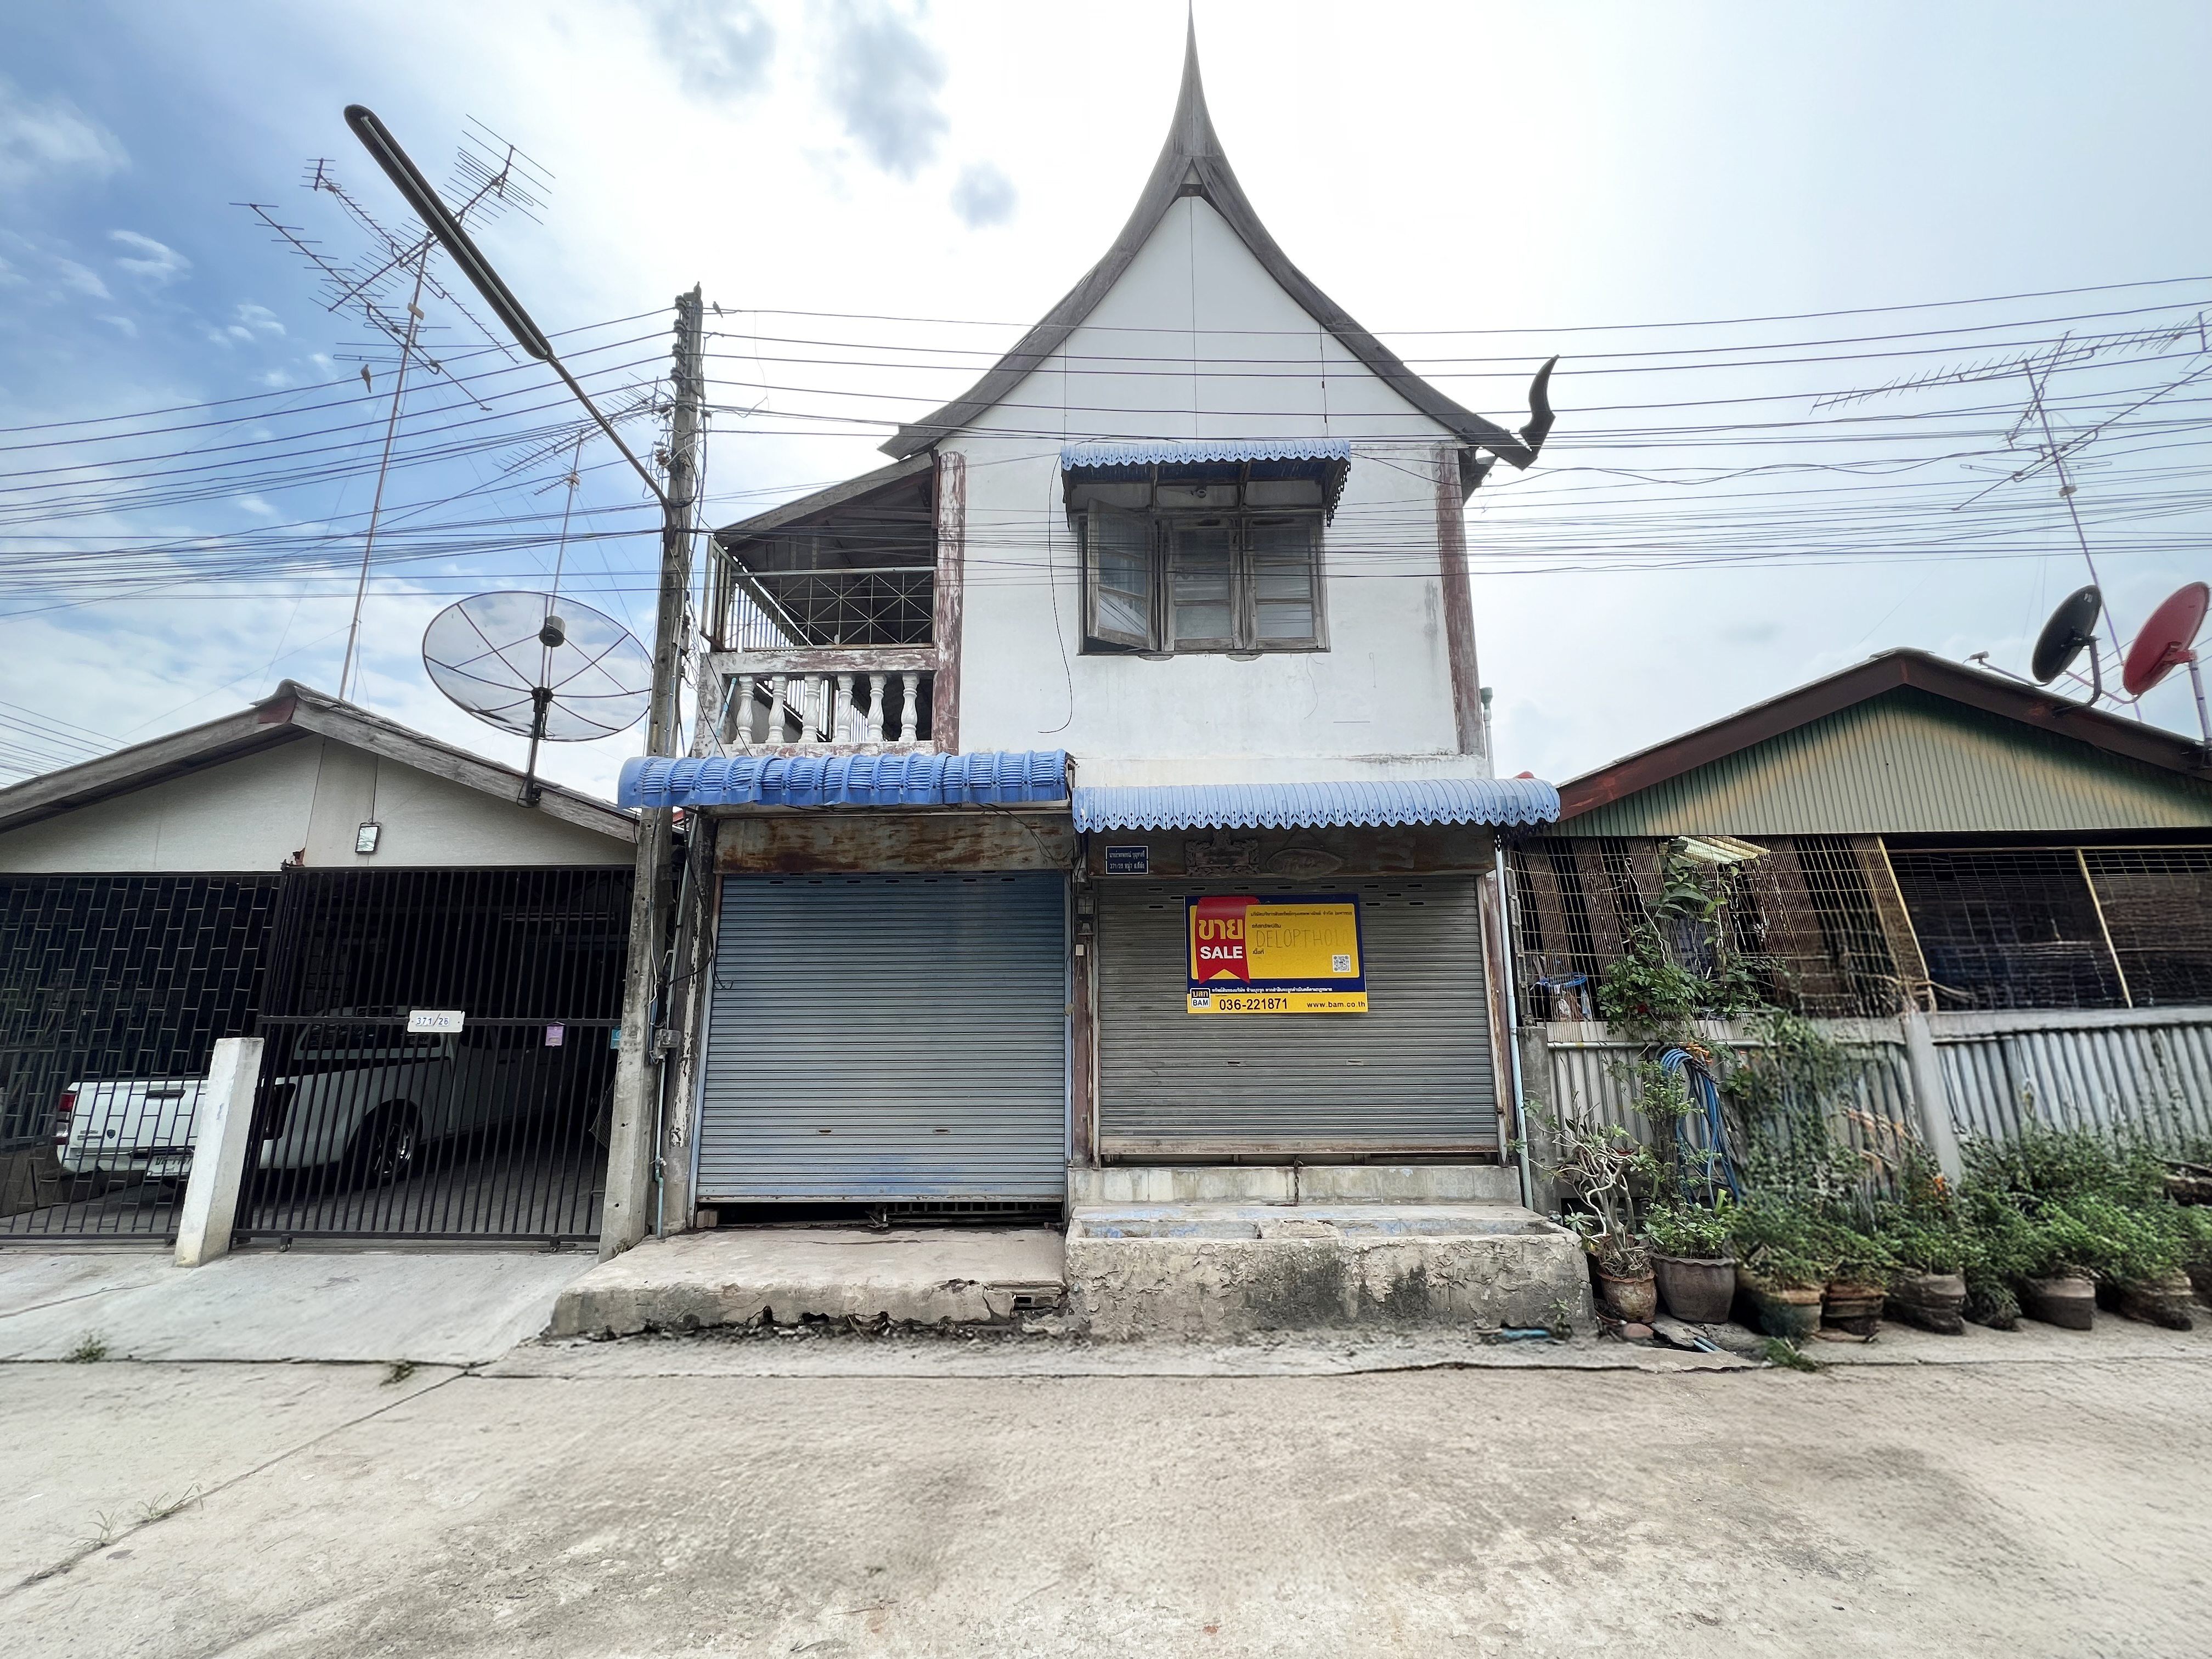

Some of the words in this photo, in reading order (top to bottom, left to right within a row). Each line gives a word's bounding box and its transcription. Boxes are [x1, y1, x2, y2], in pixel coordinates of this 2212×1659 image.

[1198, 919, 1244, 940] ขาย
[1200, 946, 1243, 959] SALE
[1219, 997, 1288, 1011] 036-221871
[416, 1013, 449, 1026] 371/26
